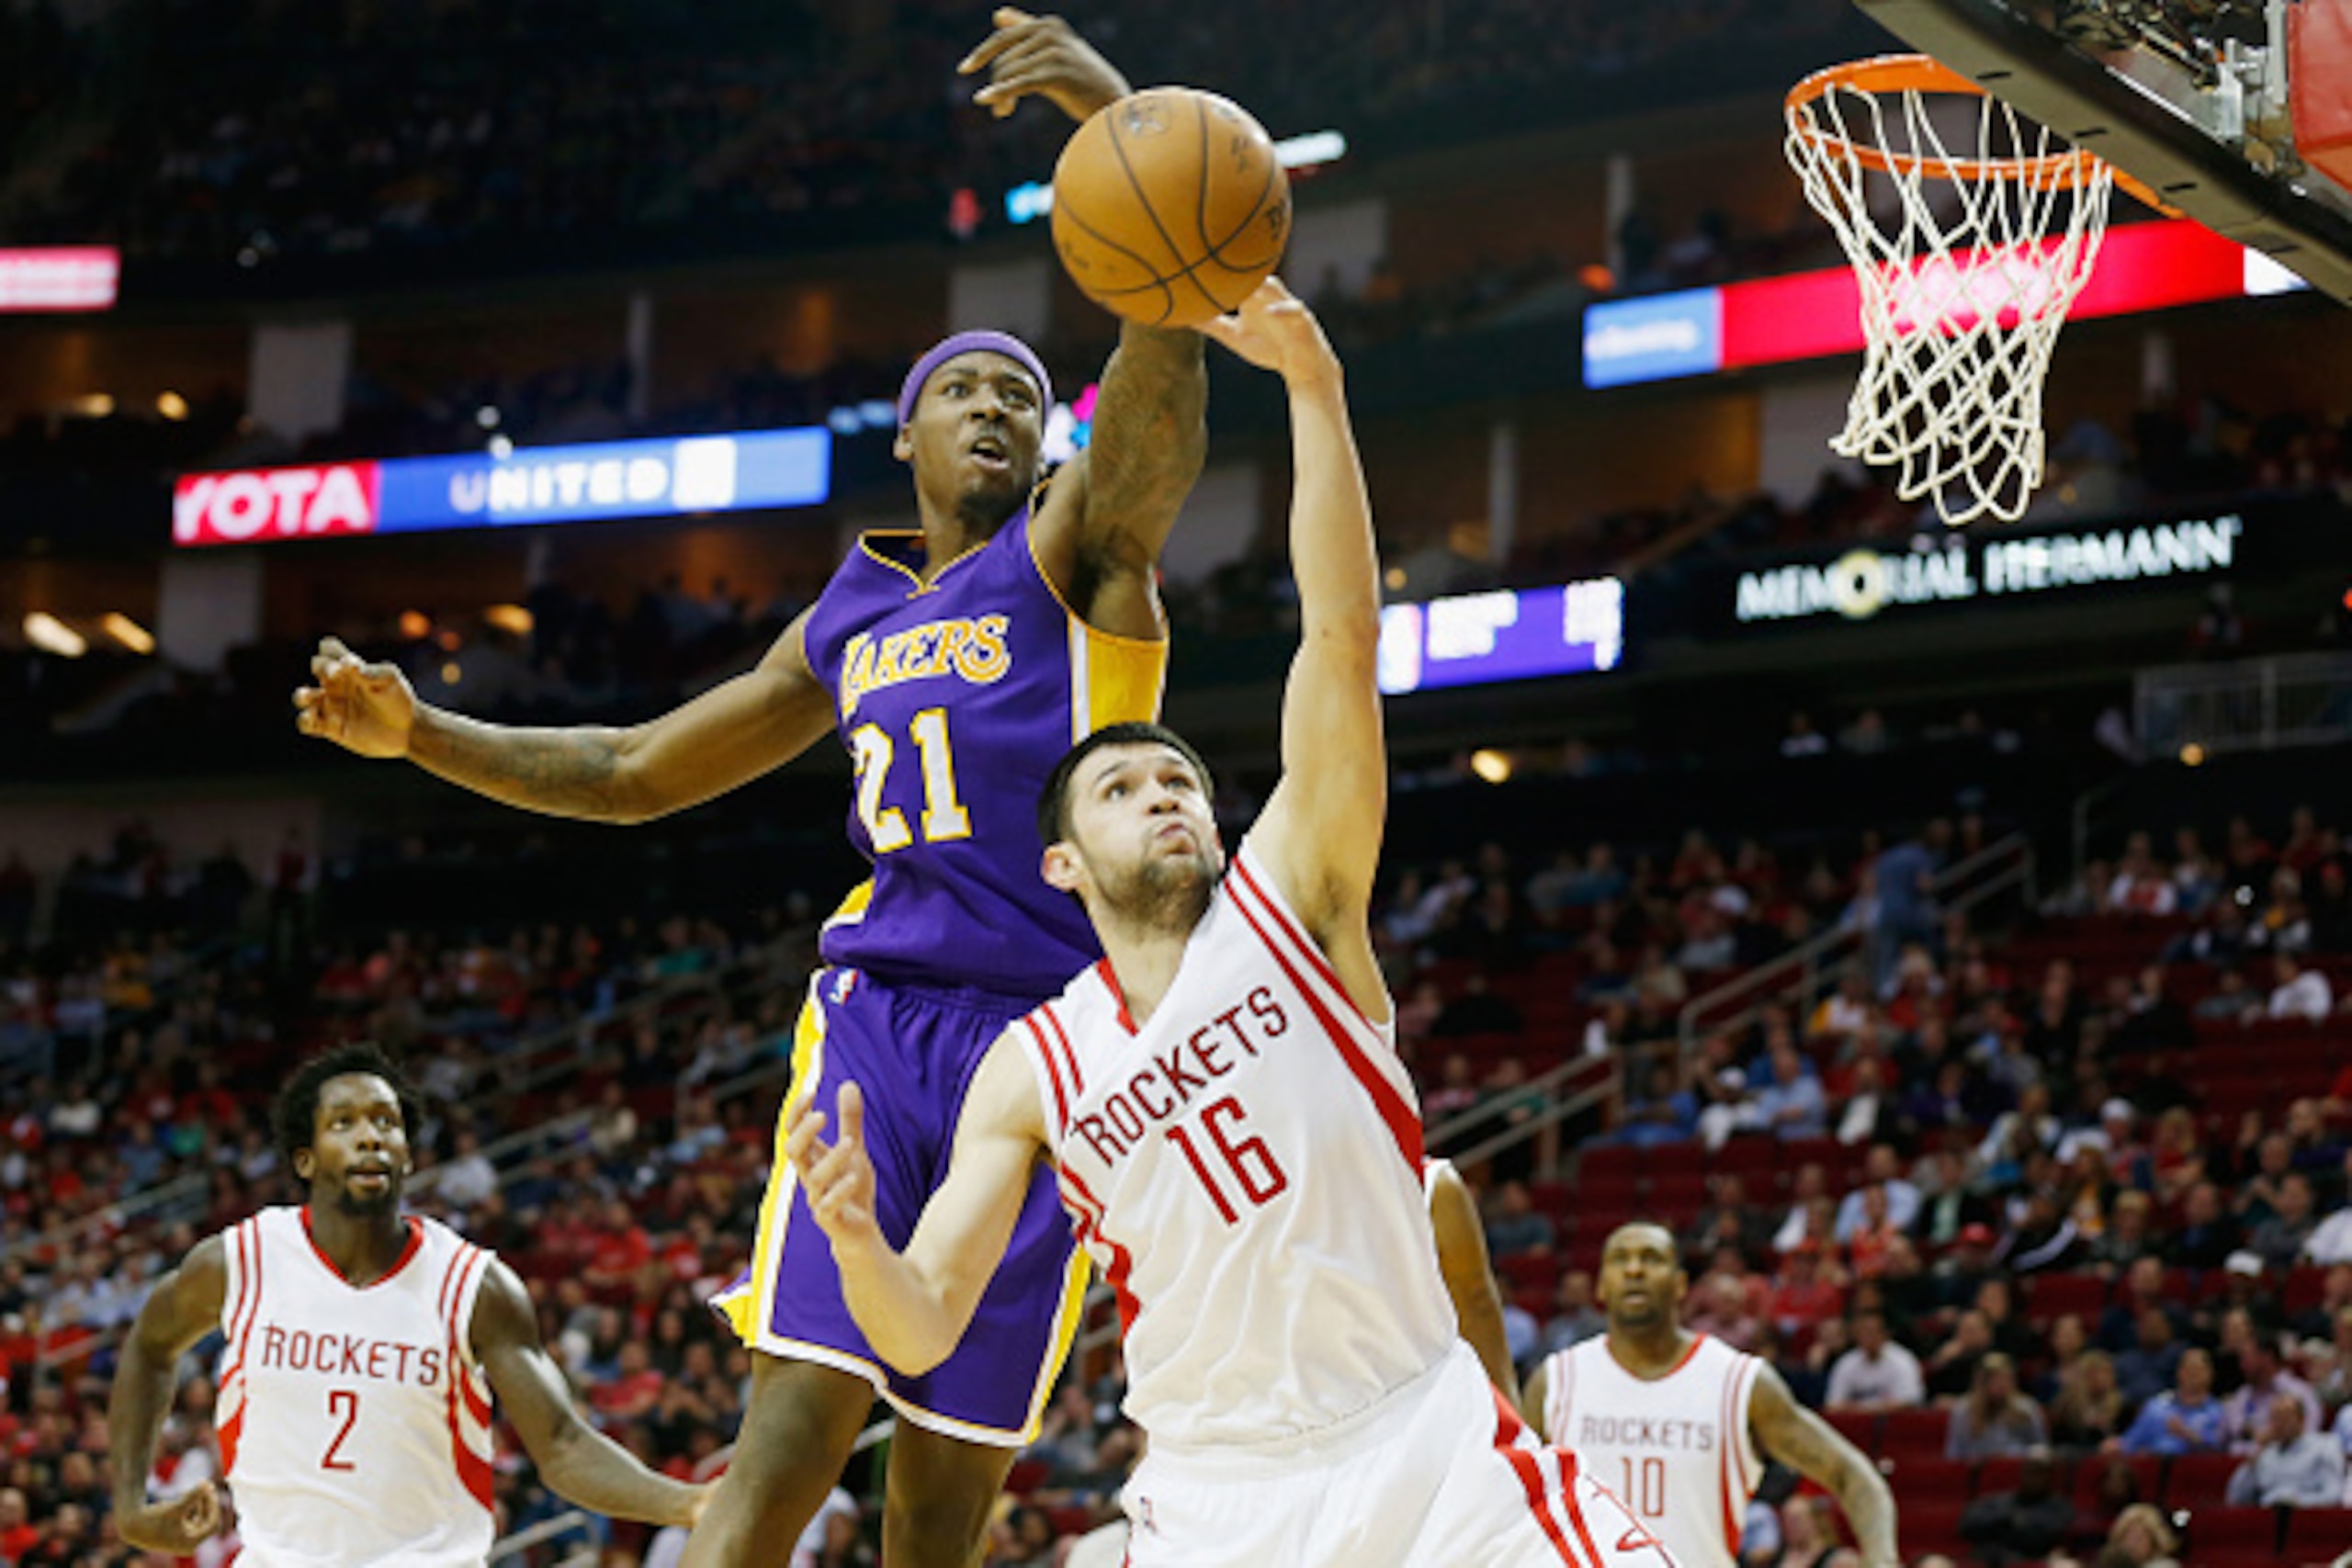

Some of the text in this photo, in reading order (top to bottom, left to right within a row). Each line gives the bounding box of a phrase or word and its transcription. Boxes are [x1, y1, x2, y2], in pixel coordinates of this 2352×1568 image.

[448, 457, 669, 513] UNITED
[1736, 516, 2234, 621] MEMORIAL HERMANN
[840, 615, 1011, 725] LAKERS
[850, 706, 972, 853] 21
[1069, 986, 1288, 1168] ROCKETS
[1165, 1094, 1288, 1227] 16
[262, 1320, 441, 1385] ROCKETS
[322, 1390, 358, 1472] 2
[1580, 1413, 1714, 1452] ROCKETS
[1621, 1455, 1665, 1517] 10
